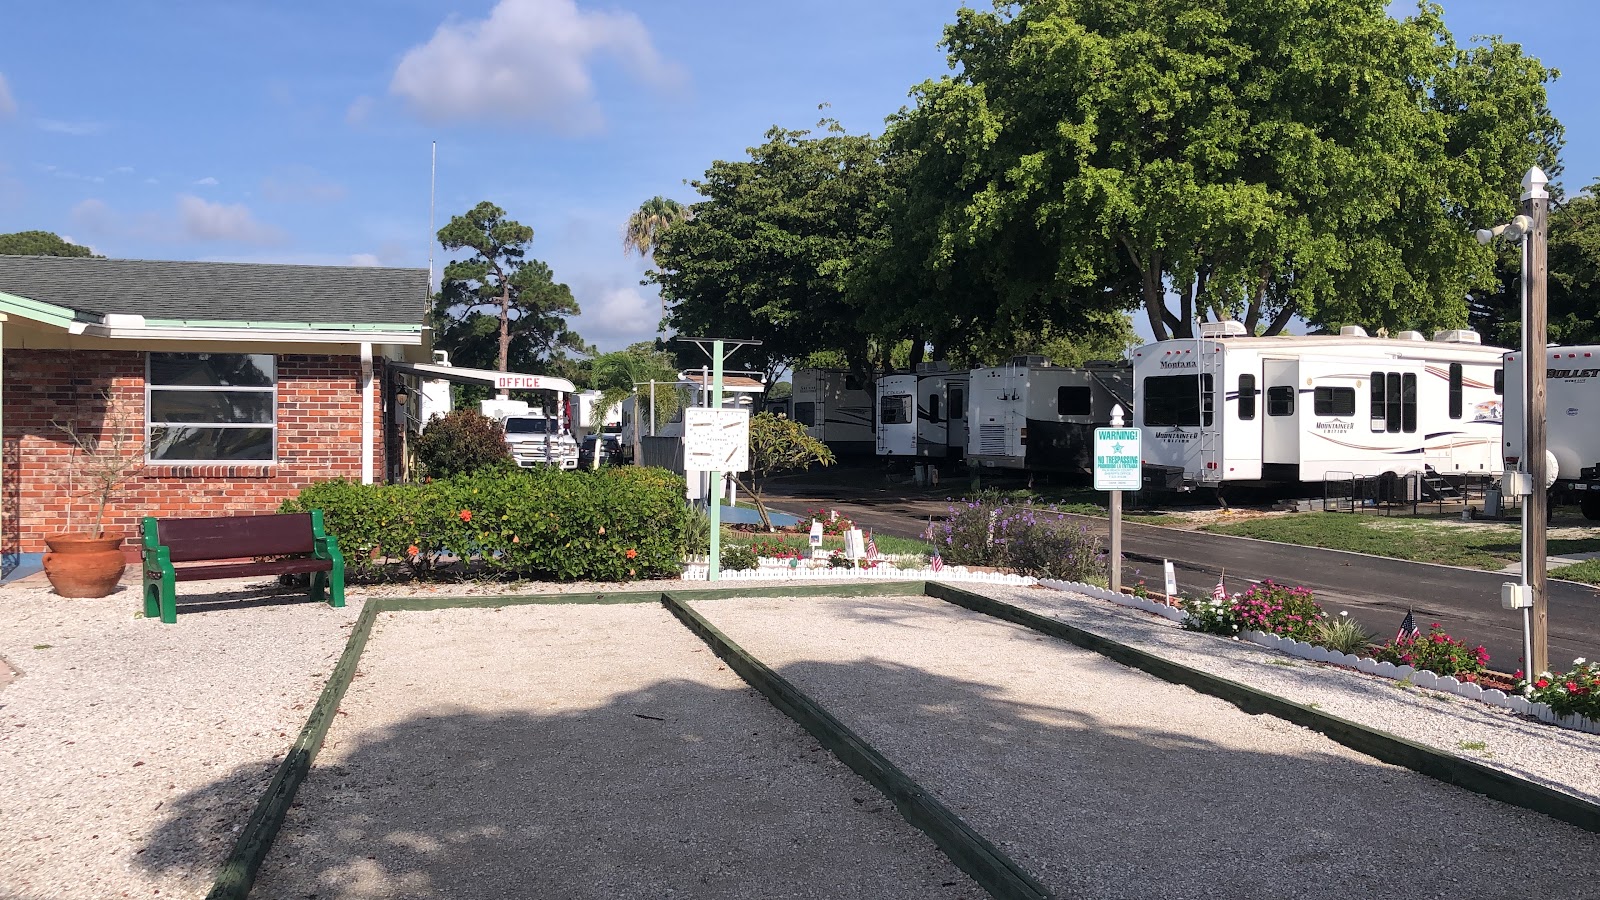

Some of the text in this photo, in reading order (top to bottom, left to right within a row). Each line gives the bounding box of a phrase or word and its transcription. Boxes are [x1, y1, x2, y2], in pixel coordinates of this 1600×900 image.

[1160, 361, 1197, 369] Montana
[1546, 368, 1600, 378] BULLET
[499, 377, 540, 387] OFFICE
[1099, 431, 1138, 440] WARNING!
[1155, 431, 1199, 439] MOUNTAINEER
